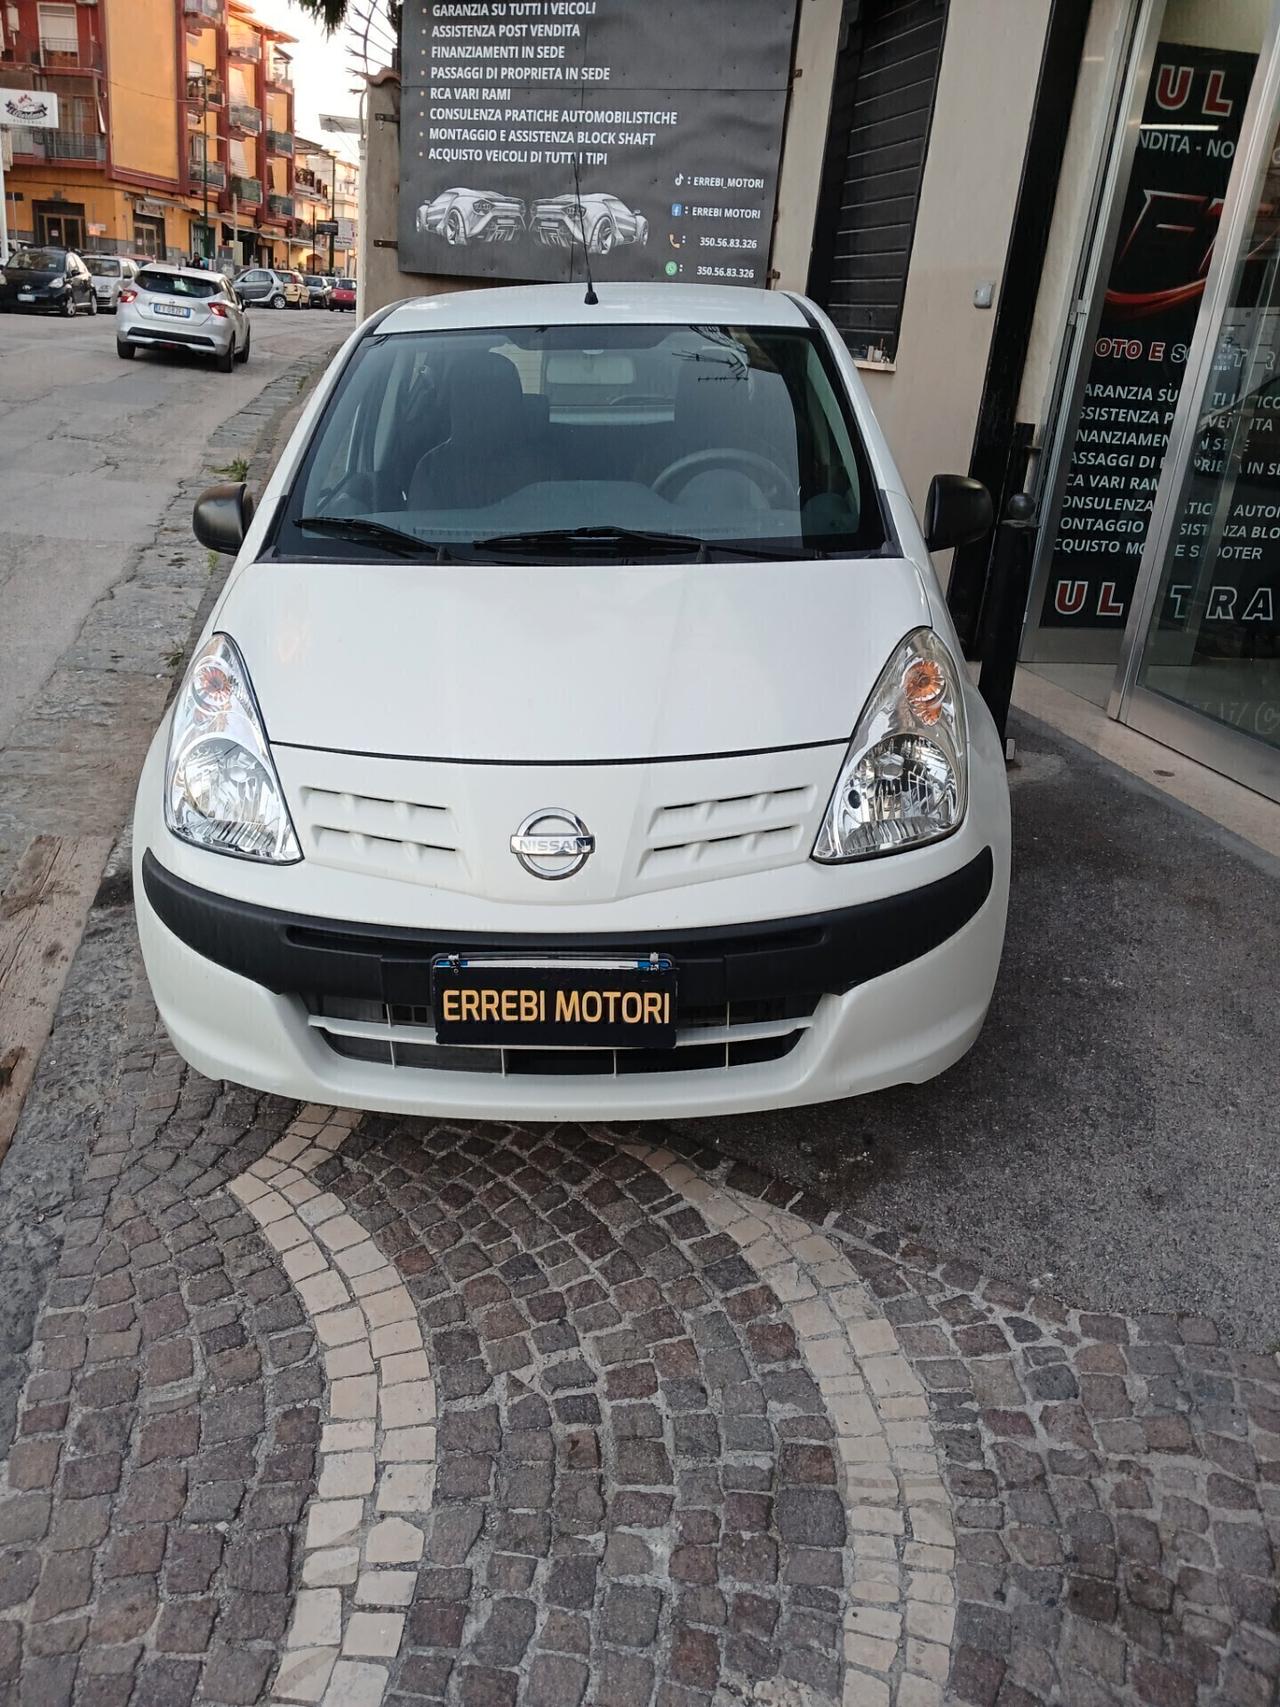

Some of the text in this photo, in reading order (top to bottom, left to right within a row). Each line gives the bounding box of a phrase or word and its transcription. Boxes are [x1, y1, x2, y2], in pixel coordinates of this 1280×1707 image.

[433, 4, 489, 17] GARANZIA
[491, 3, 506, 16] SU
[509, 3, 541, 16] TUTTI
[551, 2, 596, 15] VEICOLI
[432, 24, 581, 37] ASSISTENZA POST VENDITA
[431, 46, 565, 58] FINANZIAMENTI IN SEDE
[430, 67, 610, 80] PASSAGGI DI PROPRIETA IN SEDE
[430, 88, 511, 100] RCA VARI RAMI
[430, 108, 678, 125] CONSULENZA PRATICHE AUTOMOBILISTICHE
[429, 128, 656, 146] MONTAGGIO E ASSISTENZA BLOCK SHAFT
[1140, 131, 1191, 154] NDITA
[428, 148, 482, 163] ACQUISTO
[486, 150, 528, 163] VEICOLI
[530, 151, 542, 163] DI
[586, 152, 608, 165] TIPI
[693, 176, 764, 188] ERREBI_MOTORI
[692, 207, 722, 217] ERREBI
[724, 208, 761, 219] MOTORI
[700, 237, 757, 249] 350.56.83.326
[696, 266, 754, 278] 350.56.83.326
[1094, 337, 1143, 360] OTO
[1148, 341, 1166, 361] E
[1085, 383, 1179, 402] ARANZIA SU
[1080, 406, 1159, 424] SSISTENZA
[1075, 429, 1170, 448] NANZIAMEN
[1072, 451, 1135, 468] ASSAGGI
[1138, 456, 1156, 468] DI
[1246, 462, 1264, 475] IN
[1066, 473, 1085, 487] CA
[1089, 474, 1126, 489] VARI
[1062, 495, 1153, 512] ONSULENZA
[1060, 518, 1145, 533] ONTAGGIO
[1055, 538, 1121, 554] CQUISTO
[519, 839, 588, 852] NISSAN
[442, 989, 670, 1024] ERREBI MOTORI
